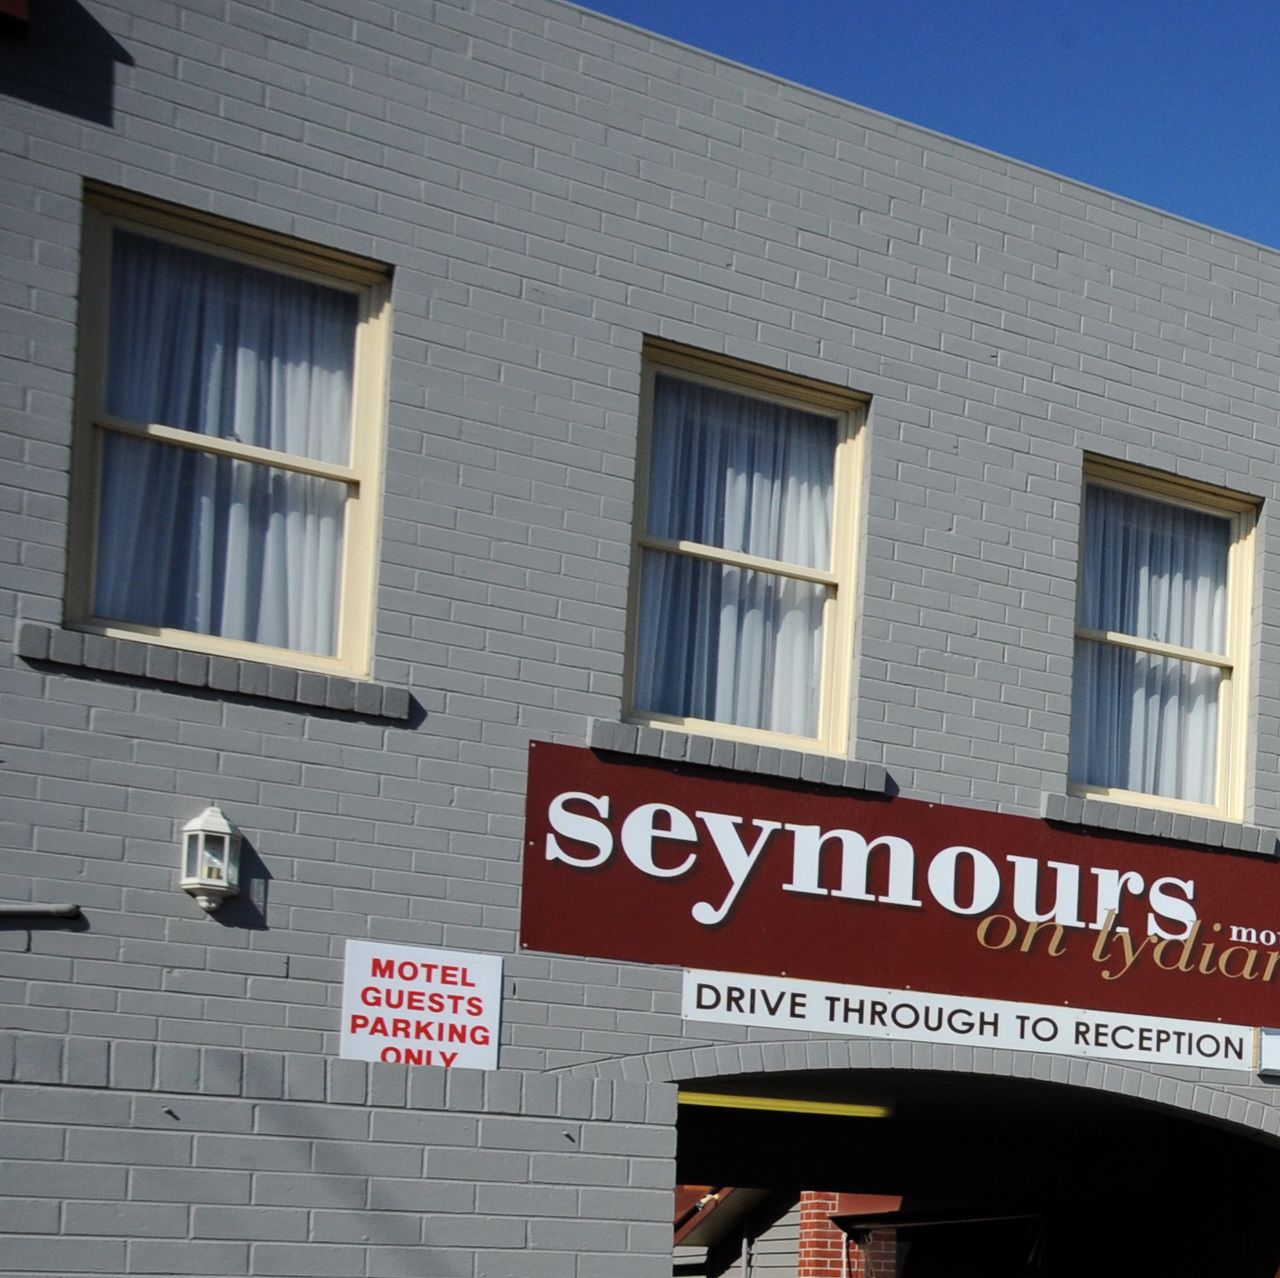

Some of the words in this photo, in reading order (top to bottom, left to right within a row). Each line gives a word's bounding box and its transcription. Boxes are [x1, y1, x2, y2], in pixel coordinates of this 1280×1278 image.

[546, 791, 1198, 942] seymours
[976, 914, 1067, 956] on
[371, 958, 476, 987] MOTEL
[361, 986, 483, 1017] GUESTS
[350, 1014, 490, 1046] PARKING
[696, 983, 807, 1019] DRIVE
[825, 996, 1000, 1037] THROUGH
[1016, 1014, 1059, 1043] TO
[1075, 1021, 1244, 1061] RECEPTION
